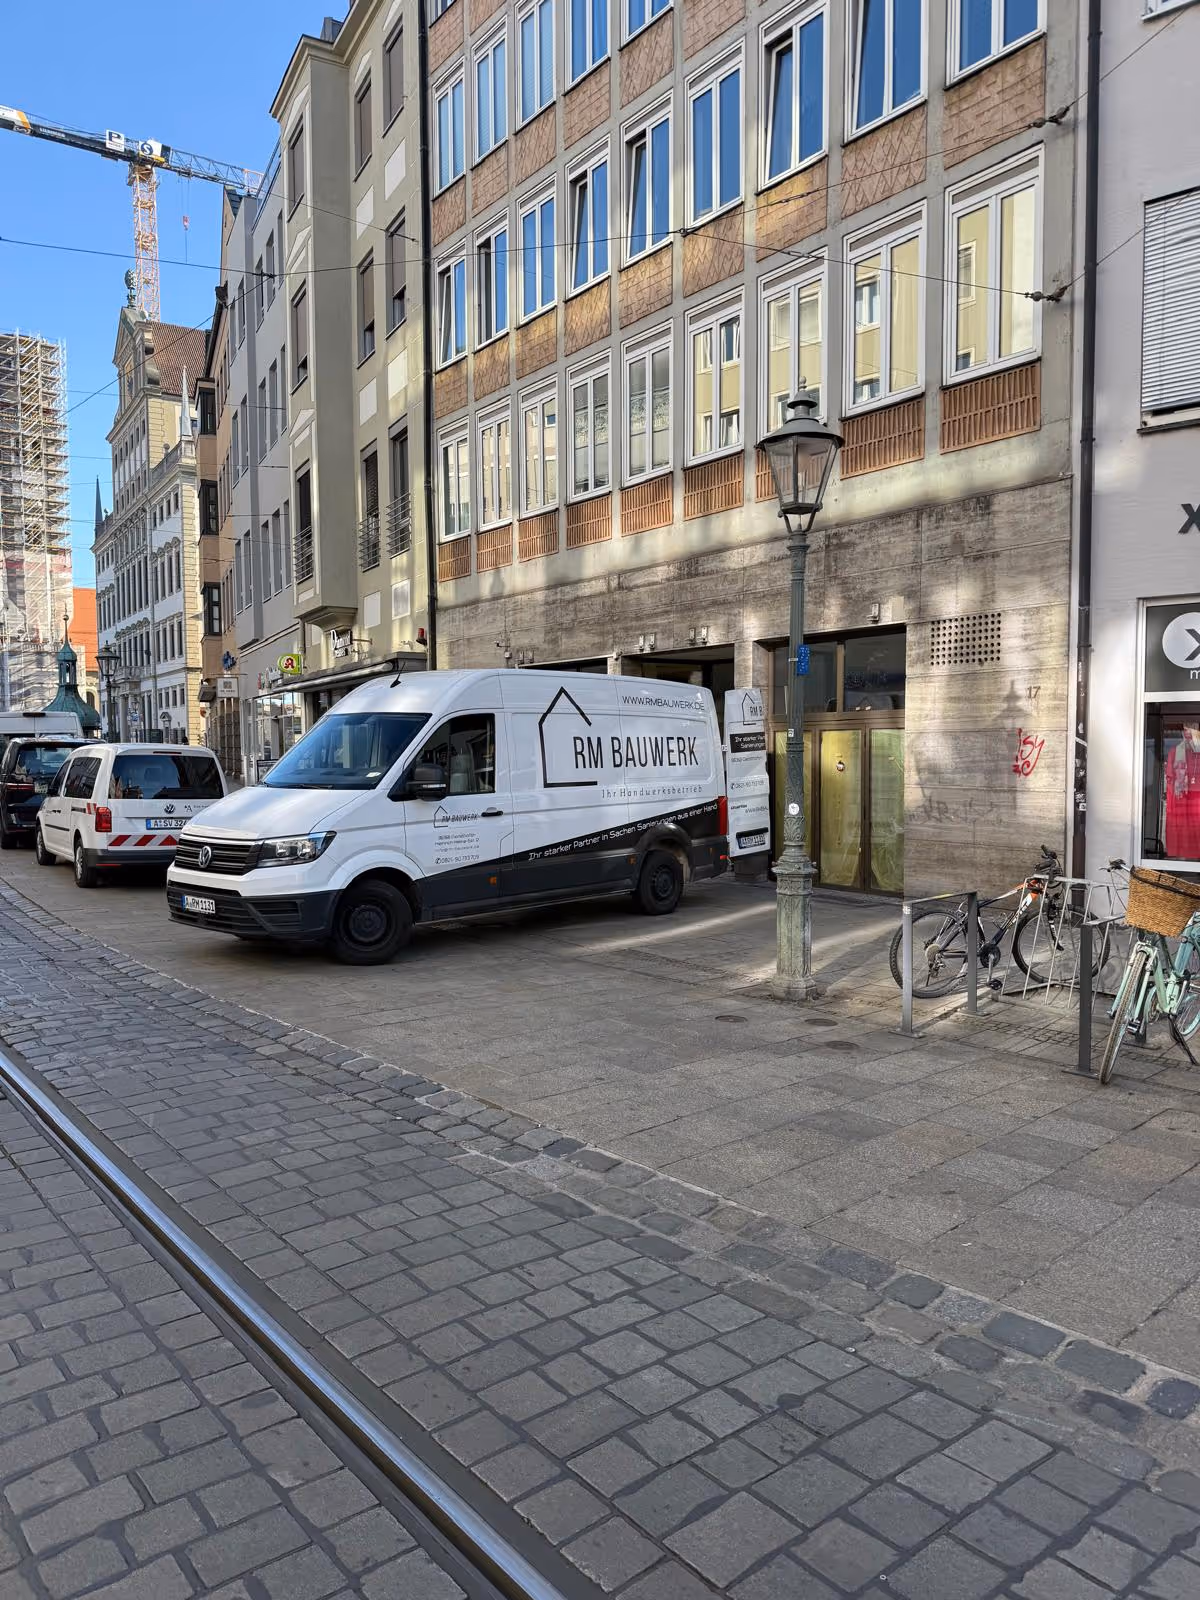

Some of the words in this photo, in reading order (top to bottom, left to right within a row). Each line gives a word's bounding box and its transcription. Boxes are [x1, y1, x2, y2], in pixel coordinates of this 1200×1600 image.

[1027, 686, 1041, 699] 17
[622, 695, 705, 711] WWW.RMBAUWERK.DE
[573, 736, 604, 769] RM
[611, 736, 699, 768] BAUWERK
[602, 788, 617, 799] Ihr
[620, 786, 703, 798] Handwerksbetrieb
[528, 852, 542, 861] Ihr
[544, 843, 572, 857] starker
[573, 837, 600, 849] Partner
[601, 833, 609, 841] in
[609, 825, 636, 839] Sachen
[677, 812, 689, 820] aus
[689, 807, 703, 817] einer
[703, 803, 718, 813] Hand
